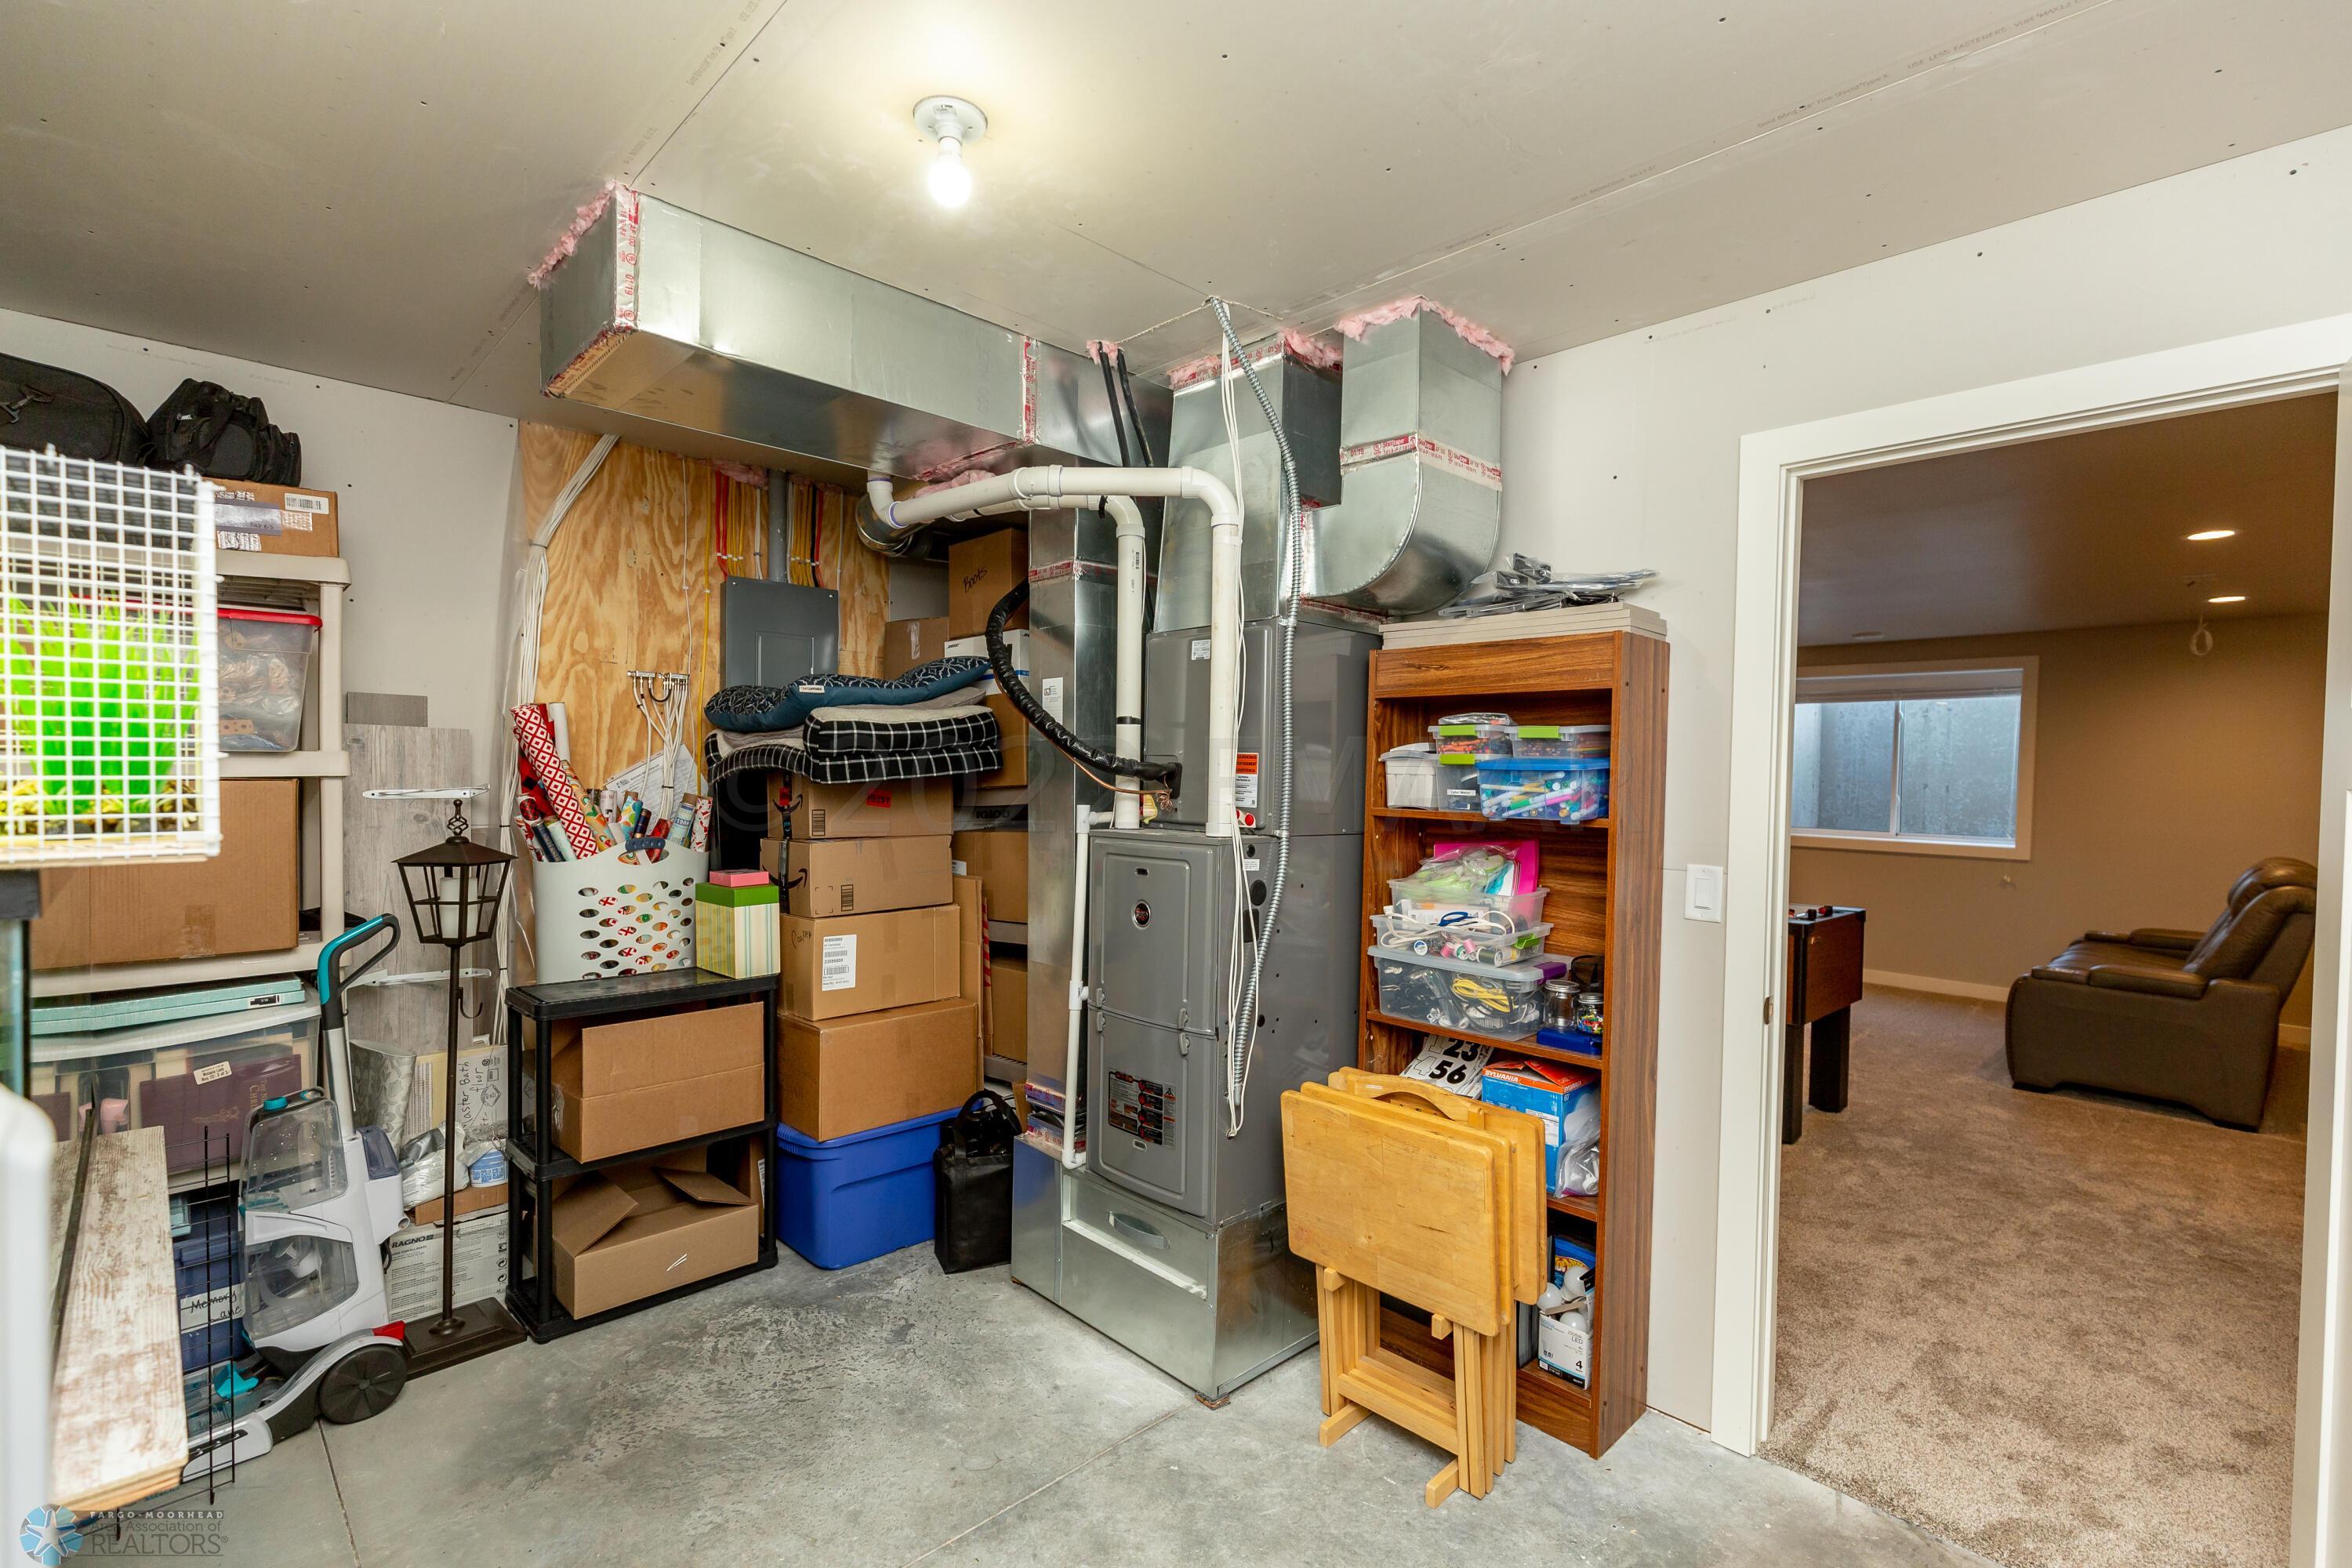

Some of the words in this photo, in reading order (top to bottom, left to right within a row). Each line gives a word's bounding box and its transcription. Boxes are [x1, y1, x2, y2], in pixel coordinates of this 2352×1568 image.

[866, 793, 891, 804] HEAVY
[976, 809, 1011, 819] IGLOO
[458, 1061, 470, 1087] Bath
[1485, 1070, 1519, 1083] SYLVANIA
[1563, 1080, 1582, 1093] SYLVANIA
[392, 1235, 426, 1248] RAGNO
[190, 1290, 237, 1314] Memory
[1571, 1336, 1583, 1345] LED
[1575, 1360, 1583, 1370] 4
